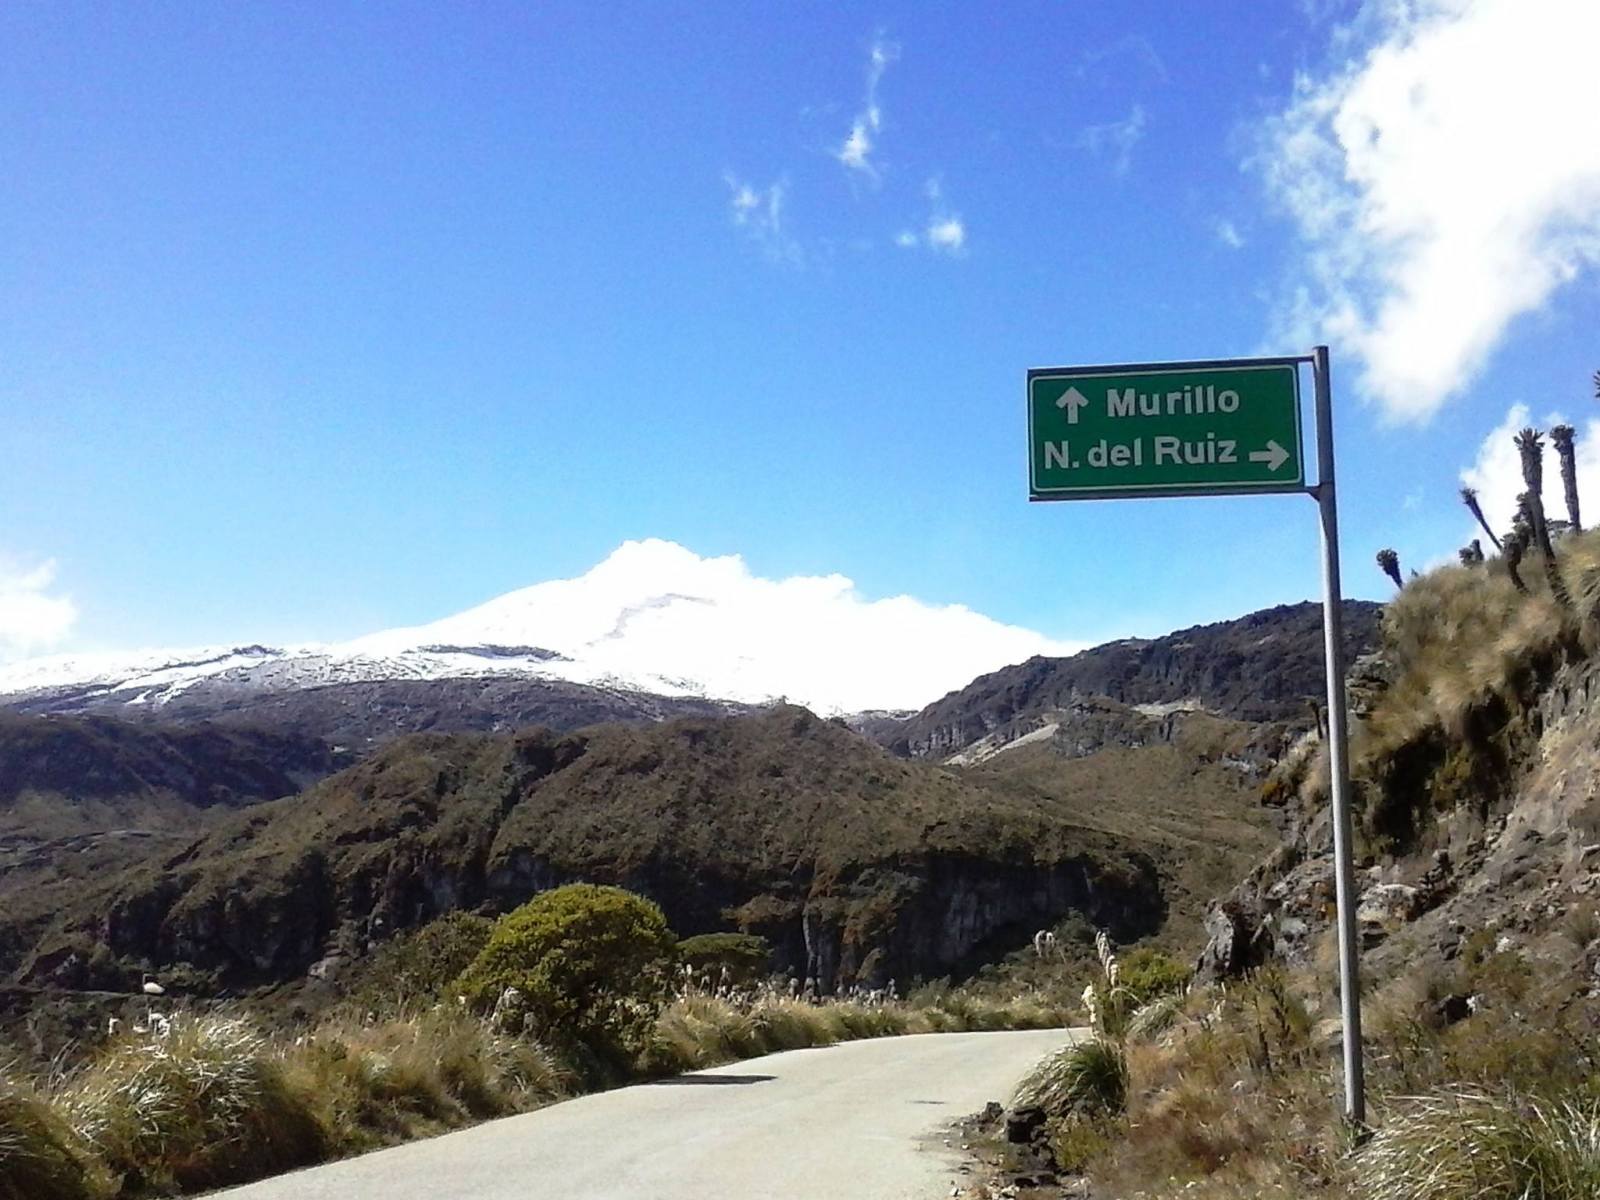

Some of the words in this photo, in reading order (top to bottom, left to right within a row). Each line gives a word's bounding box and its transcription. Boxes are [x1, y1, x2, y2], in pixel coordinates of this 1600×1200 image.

[1106, 384, 1240, 417] Murillo
[1044, 440, 1080, 469] N.
[1087, 438, 1142, 468] del
[1154, 432, 1238, 465] Ruiz
